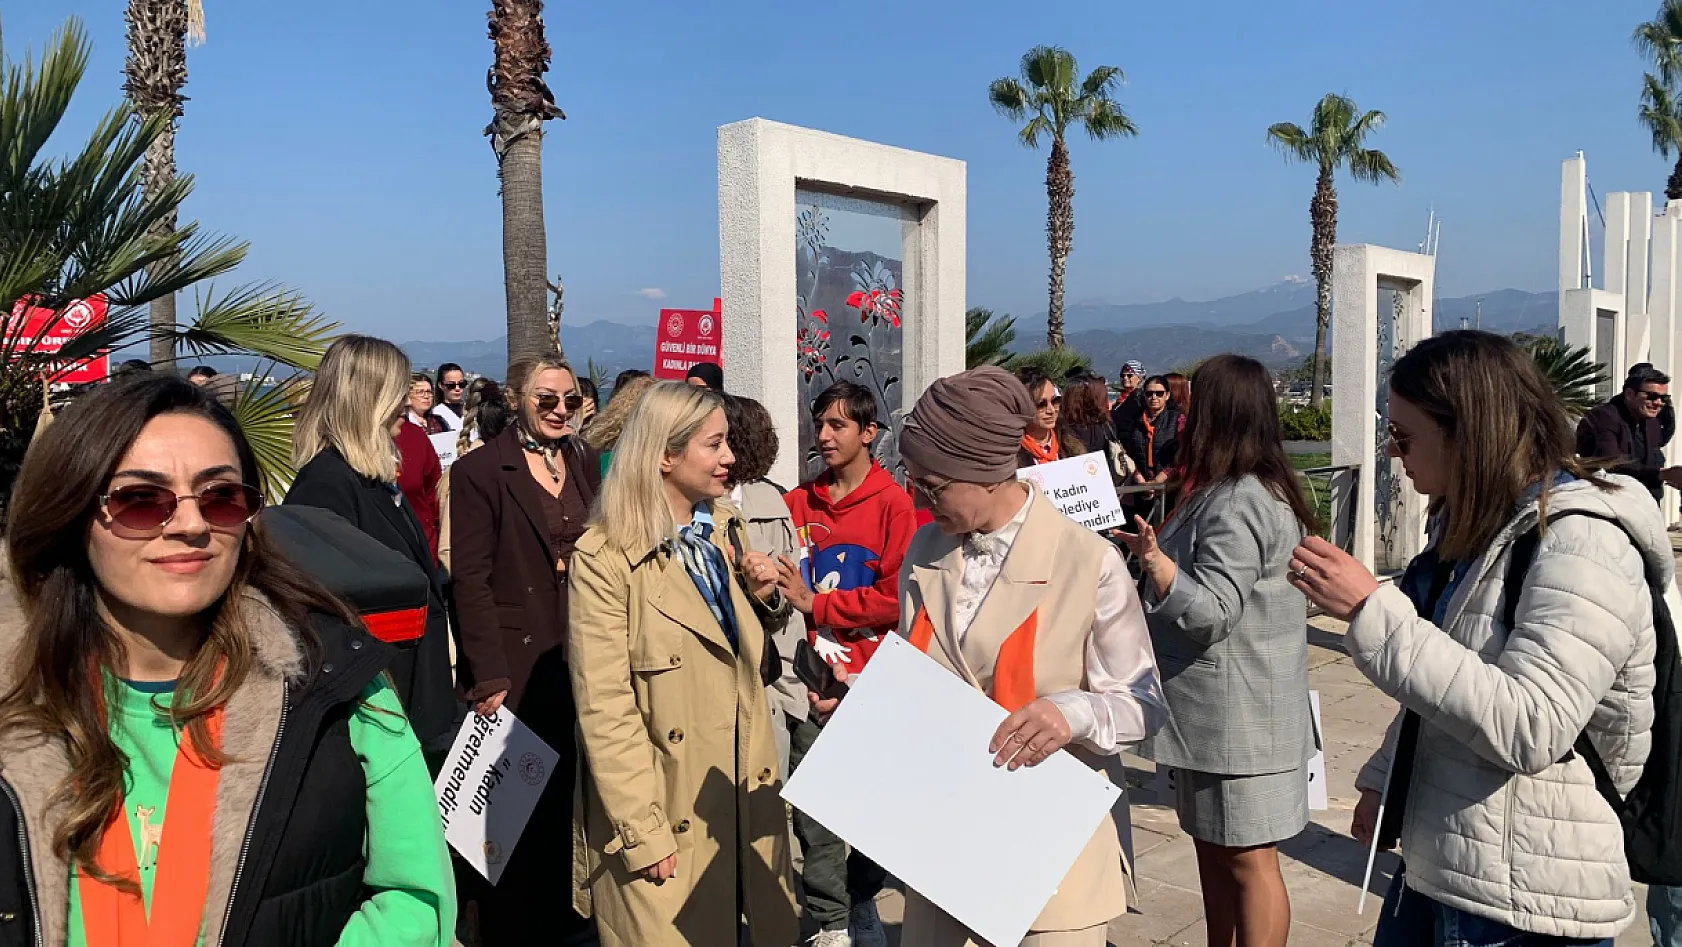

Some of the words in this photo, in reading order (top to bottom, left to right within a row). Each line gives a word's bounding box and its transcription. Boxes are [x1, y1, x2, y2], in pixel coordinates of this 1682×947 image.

[686, 342, 696, 354] BİR
[697, 343, 716, 356] DÜNYA
[1053, 484, 1088, 500] Kadın
[469, 763, 504, 816] Kadın
